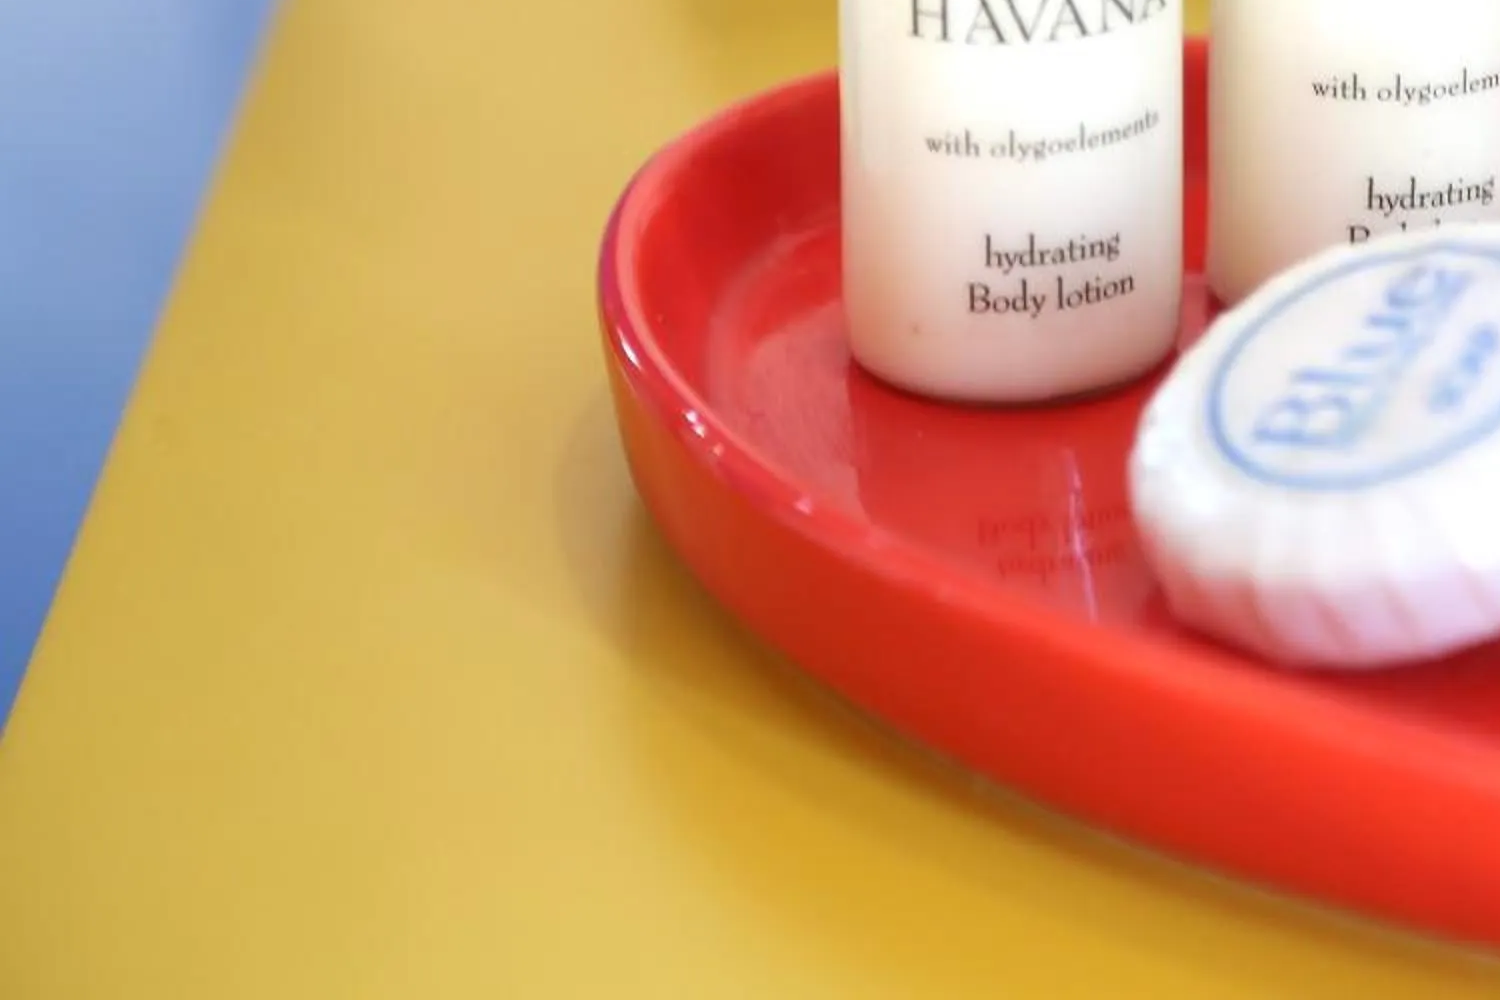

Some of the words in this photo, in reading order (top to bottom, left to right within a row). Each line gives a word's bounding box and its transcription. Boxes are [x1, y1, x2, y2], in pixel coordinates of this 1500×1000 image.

[1311, 72, 1367, 101] with
[924, 126, 981, 158] with
[989, 107, 1159, 163] olygoelements
[1366, 175, 1496, 218] hydrating
[983, 231, 1121, 276] hydrating
[967, 282, 1047, 319] Body
[1055, 270, 1135, 310] lotion
[1253, 265, 1437, 447] Blue
